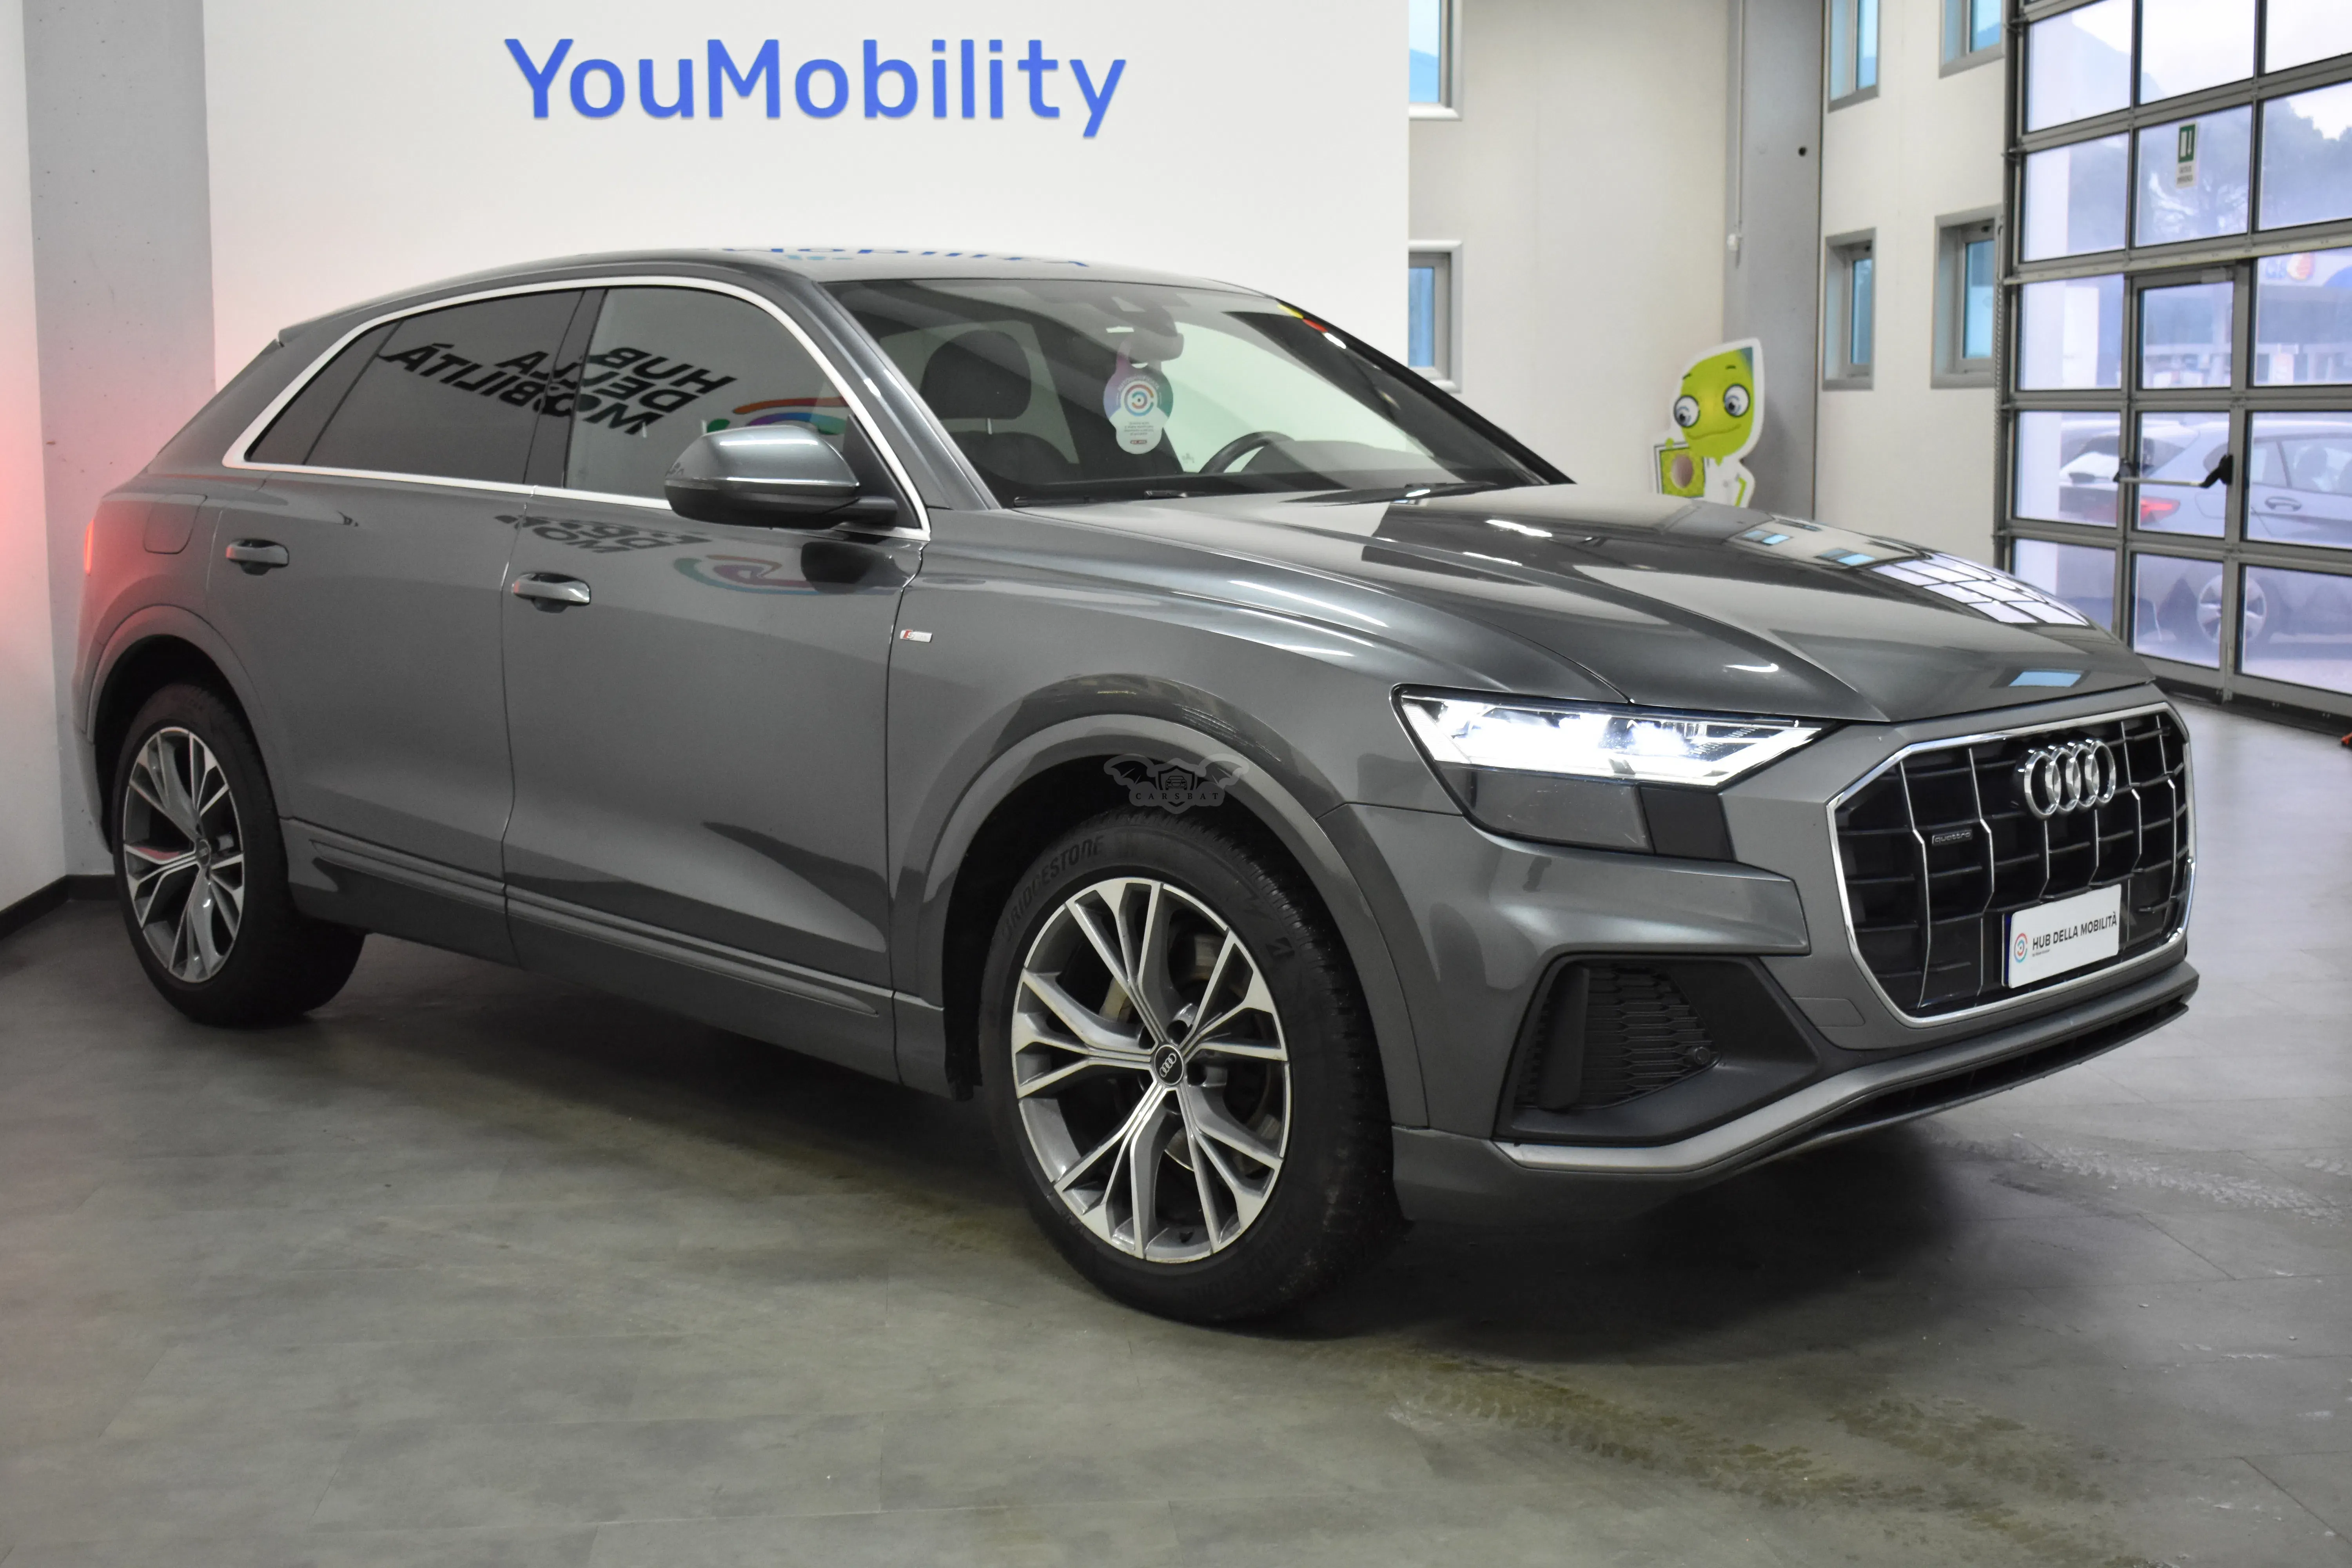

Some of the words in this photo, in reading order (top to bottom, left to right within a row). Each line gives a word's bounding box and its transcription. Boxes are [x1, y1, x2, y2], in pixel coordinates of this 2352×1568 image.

[505, 38, 1126, 138] YouMobility
[1935, 830, 1972, 844] quattro
[2032, 933, 2051, 950] HUB
[2053, 926, 2078, 944] DELLA
[2081, 911, 2118, 935] MOBILITÀ
